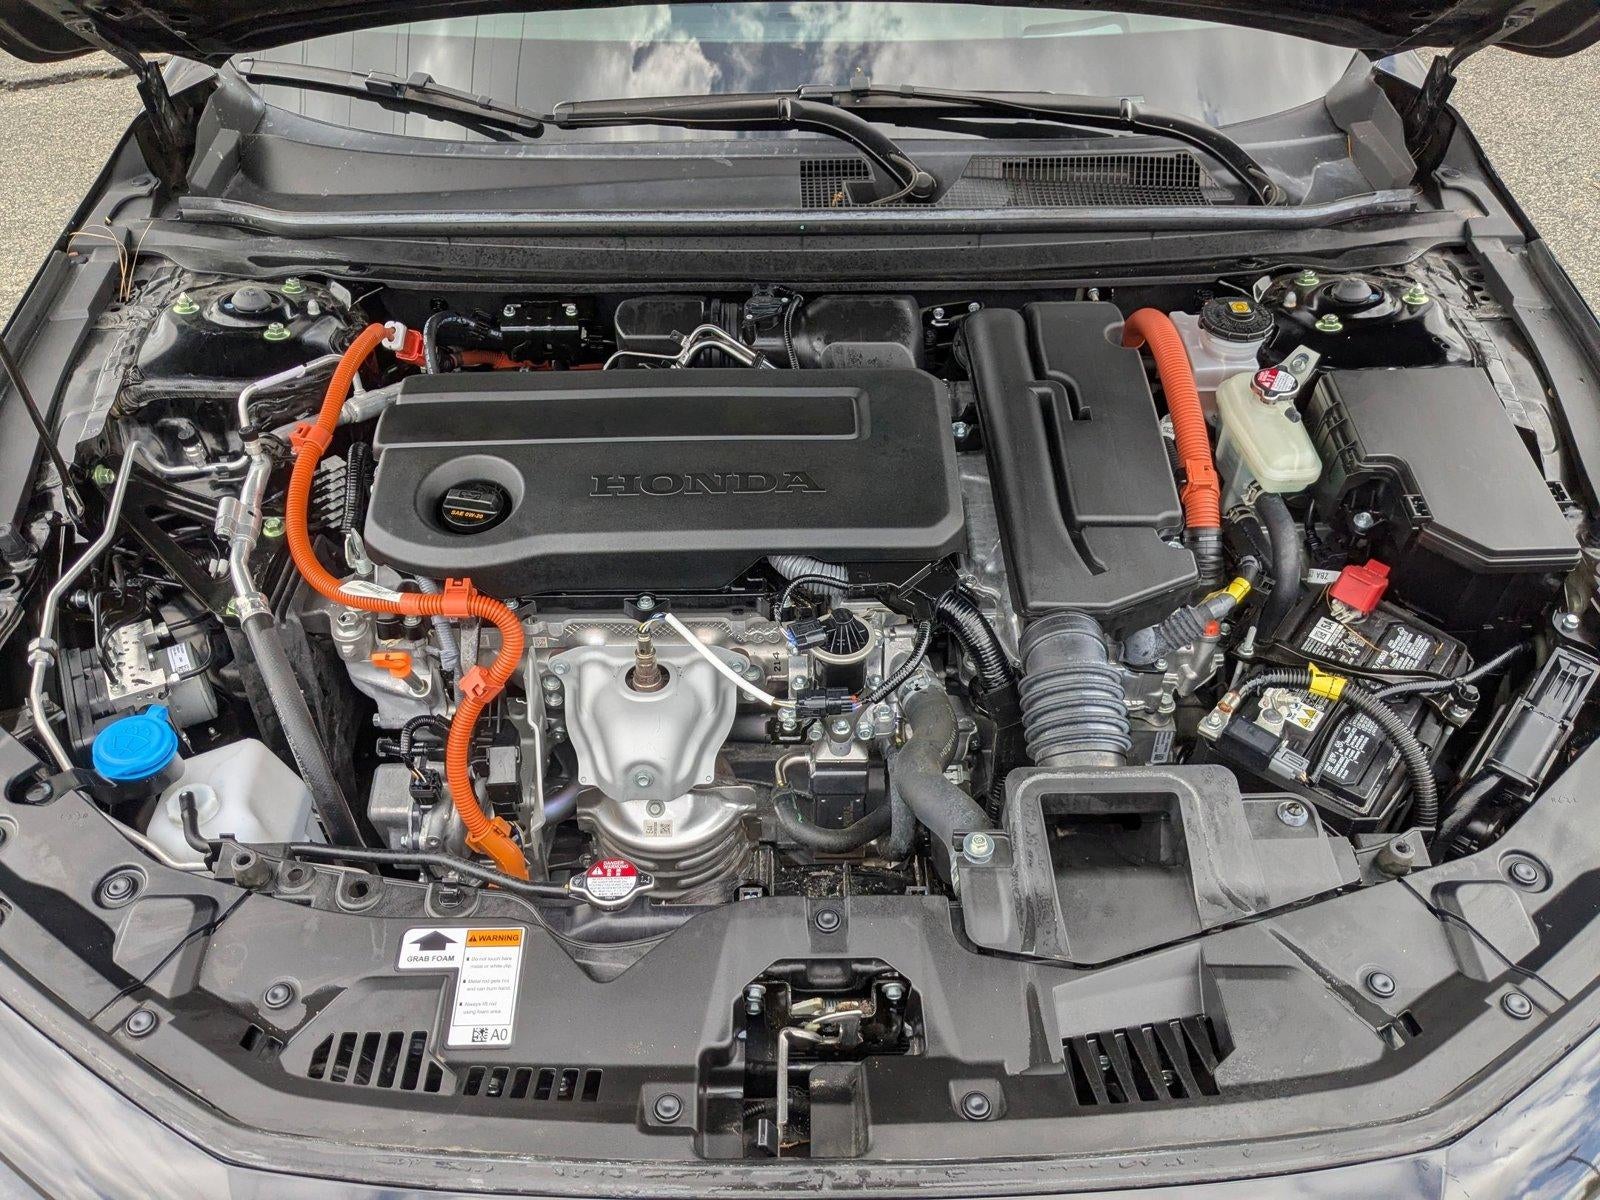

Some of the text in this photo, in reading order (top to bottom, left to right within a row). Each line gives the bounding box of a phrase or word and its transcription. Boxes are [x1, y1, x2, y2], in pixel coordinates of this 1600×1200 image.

[589, 471, 827, 497] HONDA
[450, 509, 484, 519] SAE 0W-20
[773, 651, 782, 672] 214
[478, 934, 519, 942] WARNING
[407, 954, 455, 963] GRAB FOAM
[490, 1028, 508, 1041] A0
